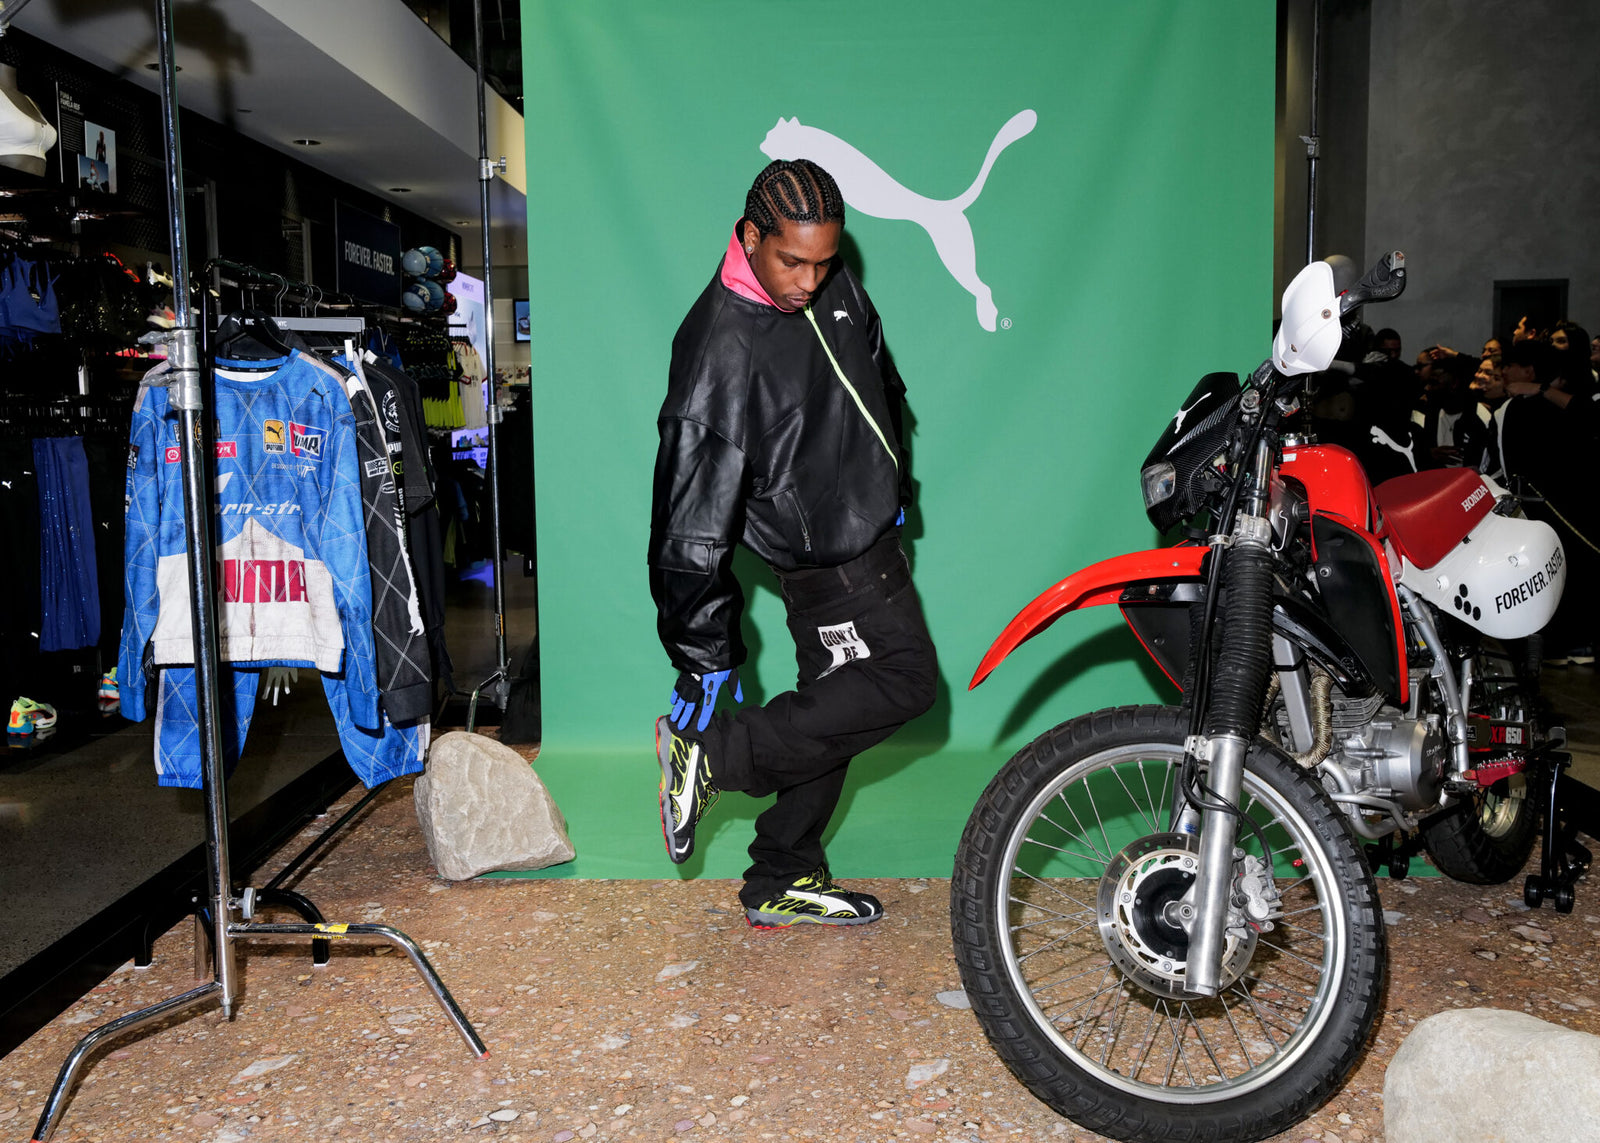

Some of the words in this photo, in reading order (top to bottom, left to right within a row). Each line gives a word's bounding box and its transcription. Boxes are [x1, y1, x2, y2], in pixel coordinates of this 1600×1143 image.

[344, 240, 372, 268] FOREVER.
[373, 250, 395, 276] FASTER.
[293, 434, 320, 455] UMA
[1461, 484, 1489, 512] HONDA
[216, 559, 309, 603] UMA
[1495, 571, 1549, 614] FOREVER.
[821, 626, 859, 647] DON'T
[1490, 725, 1527, 745] XR650L
[1334, 855, 1354, 912] TRAIL
[1344, 921, 1362, 1004] MASTER
